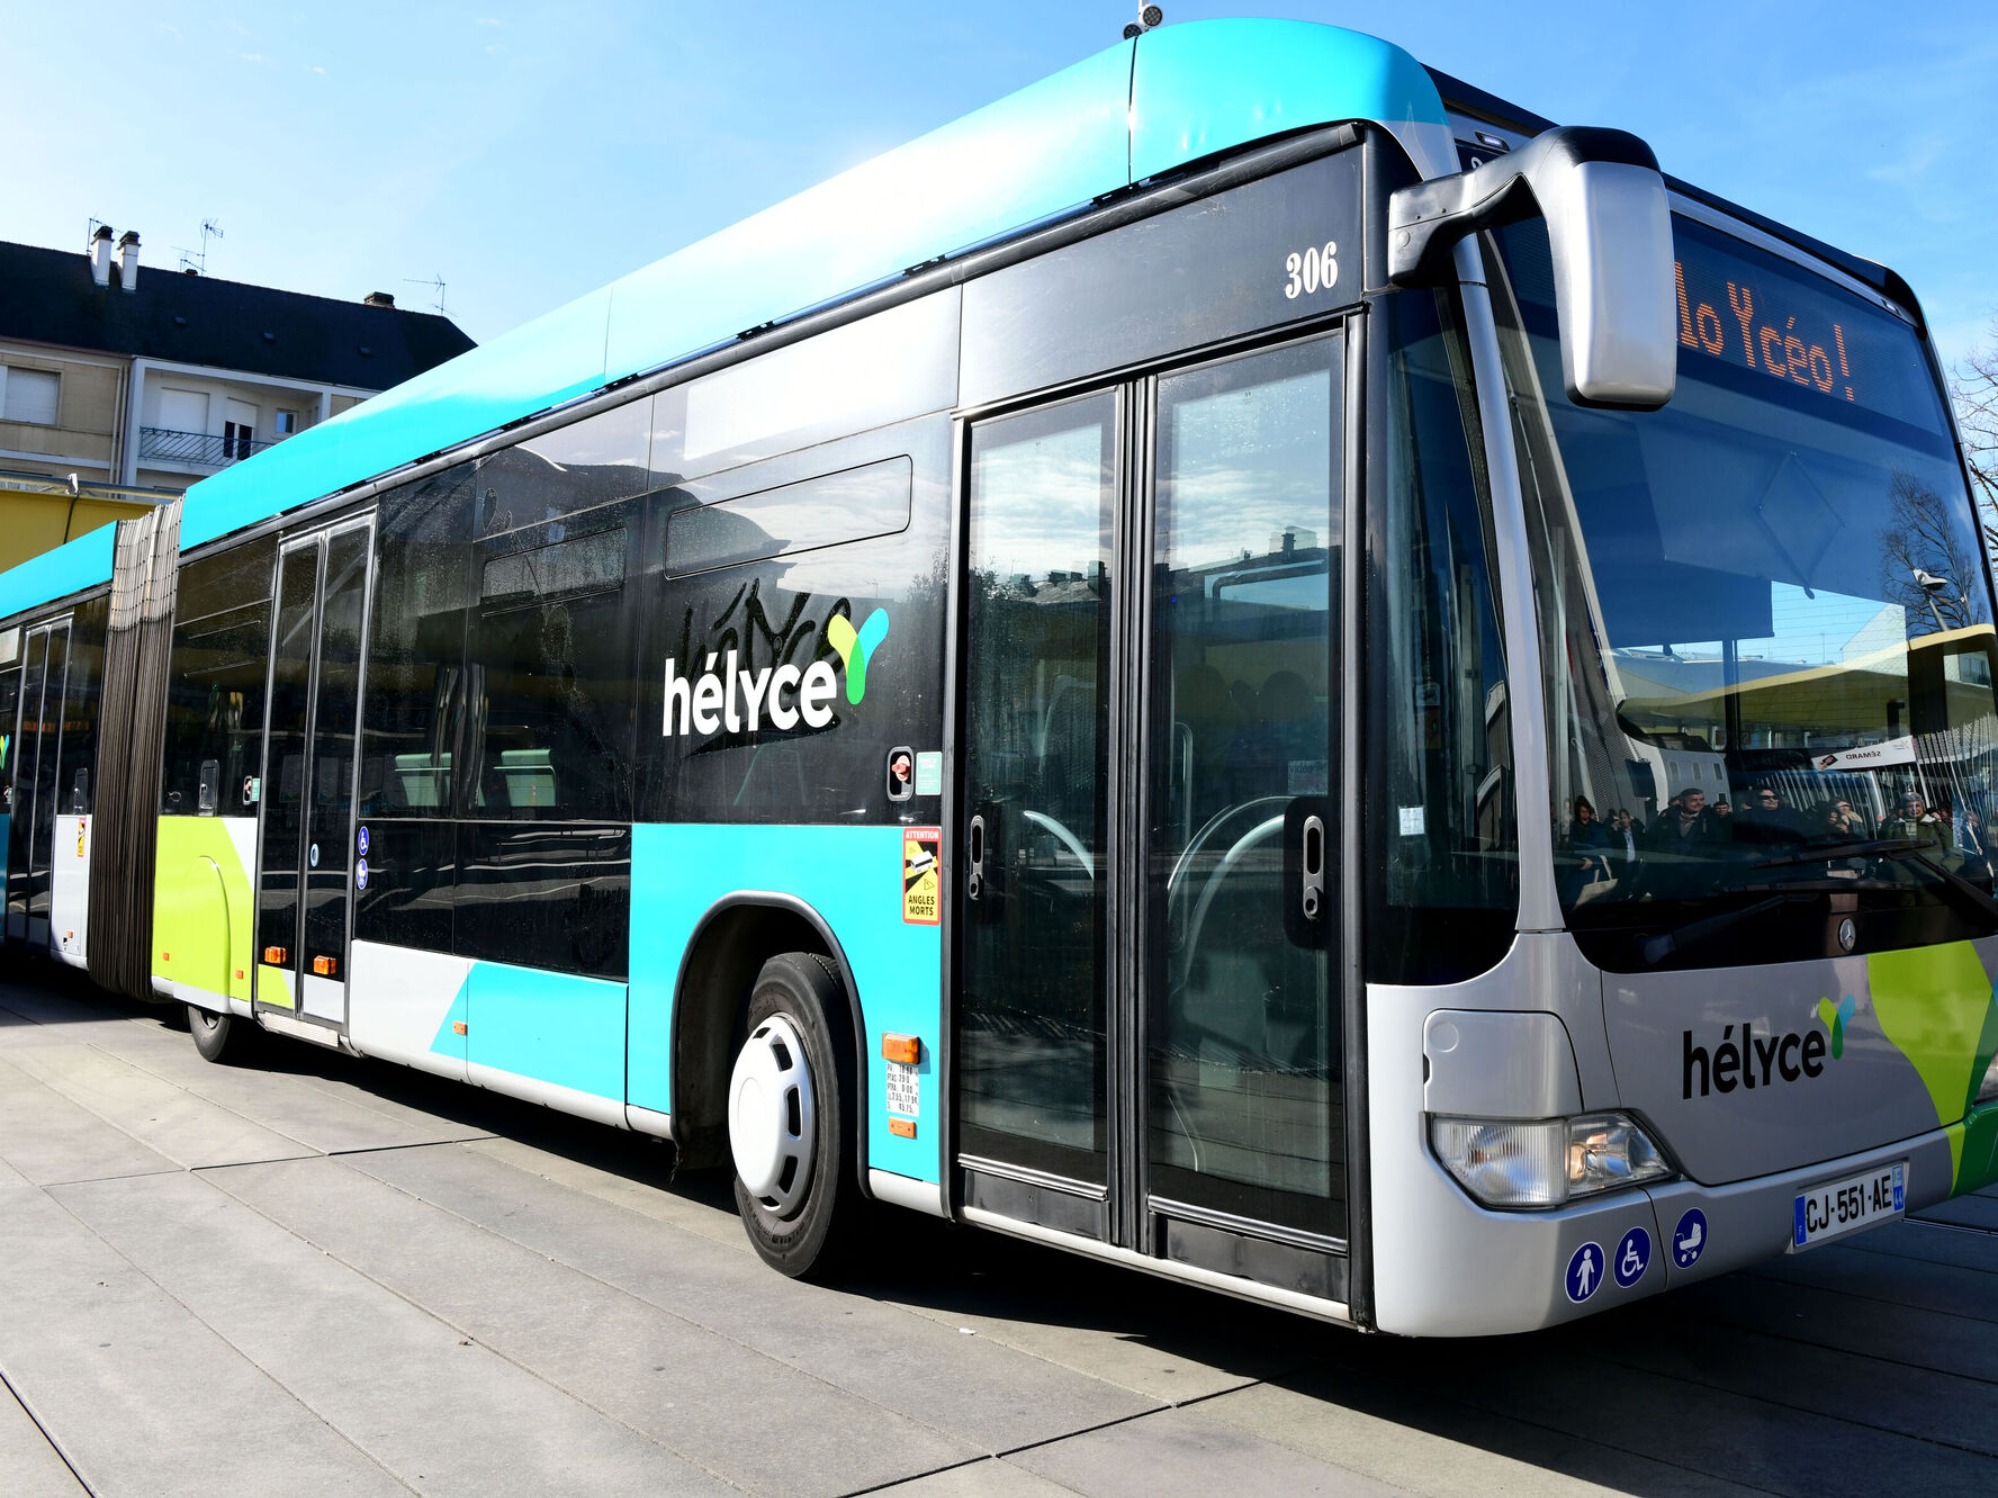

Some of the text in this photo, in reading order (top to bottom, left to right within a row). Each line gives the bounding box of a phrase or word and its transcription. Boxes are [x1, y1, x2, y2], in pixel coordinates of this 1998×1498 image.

[1285, 241, 1338, 299] 306
[1675, 261, 1724, 361] lo
[662, 649, 837, 737] hélyce
[905, 830, 939, 840] ATTENTION
[908, 894, 935, 906] ANGLES
[909, 905, 934, 916] MORTS
[1683, 1023, 1826, 1099] hélyce
[1806, 1175, 1892, 1233] CJ-551-AE
